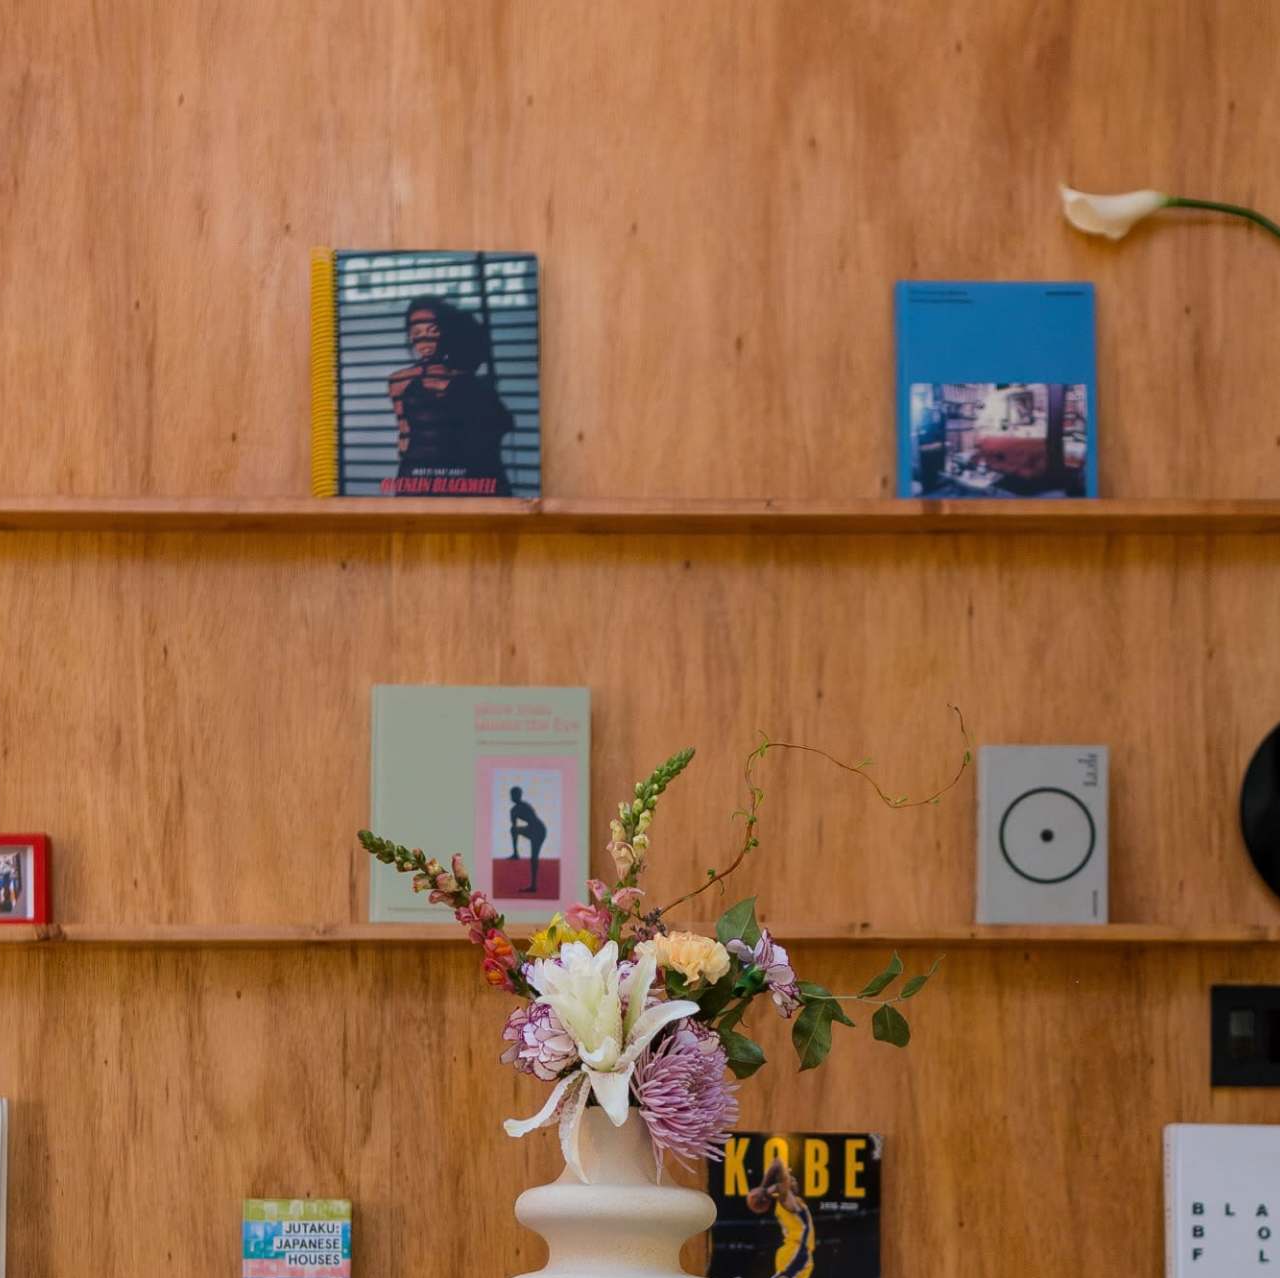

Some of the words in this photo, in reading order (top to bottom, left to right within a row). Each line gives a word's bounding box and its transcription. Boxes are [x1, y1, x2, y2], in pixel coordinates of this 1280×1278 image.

[724, 1136, 866, 1198] KOBE
[285, 1223, 339, 1234] JUTAKU:
[276, 1238, 340, 1250] JAPANESE
[288, 1254, 340, 1265] HOUSES
